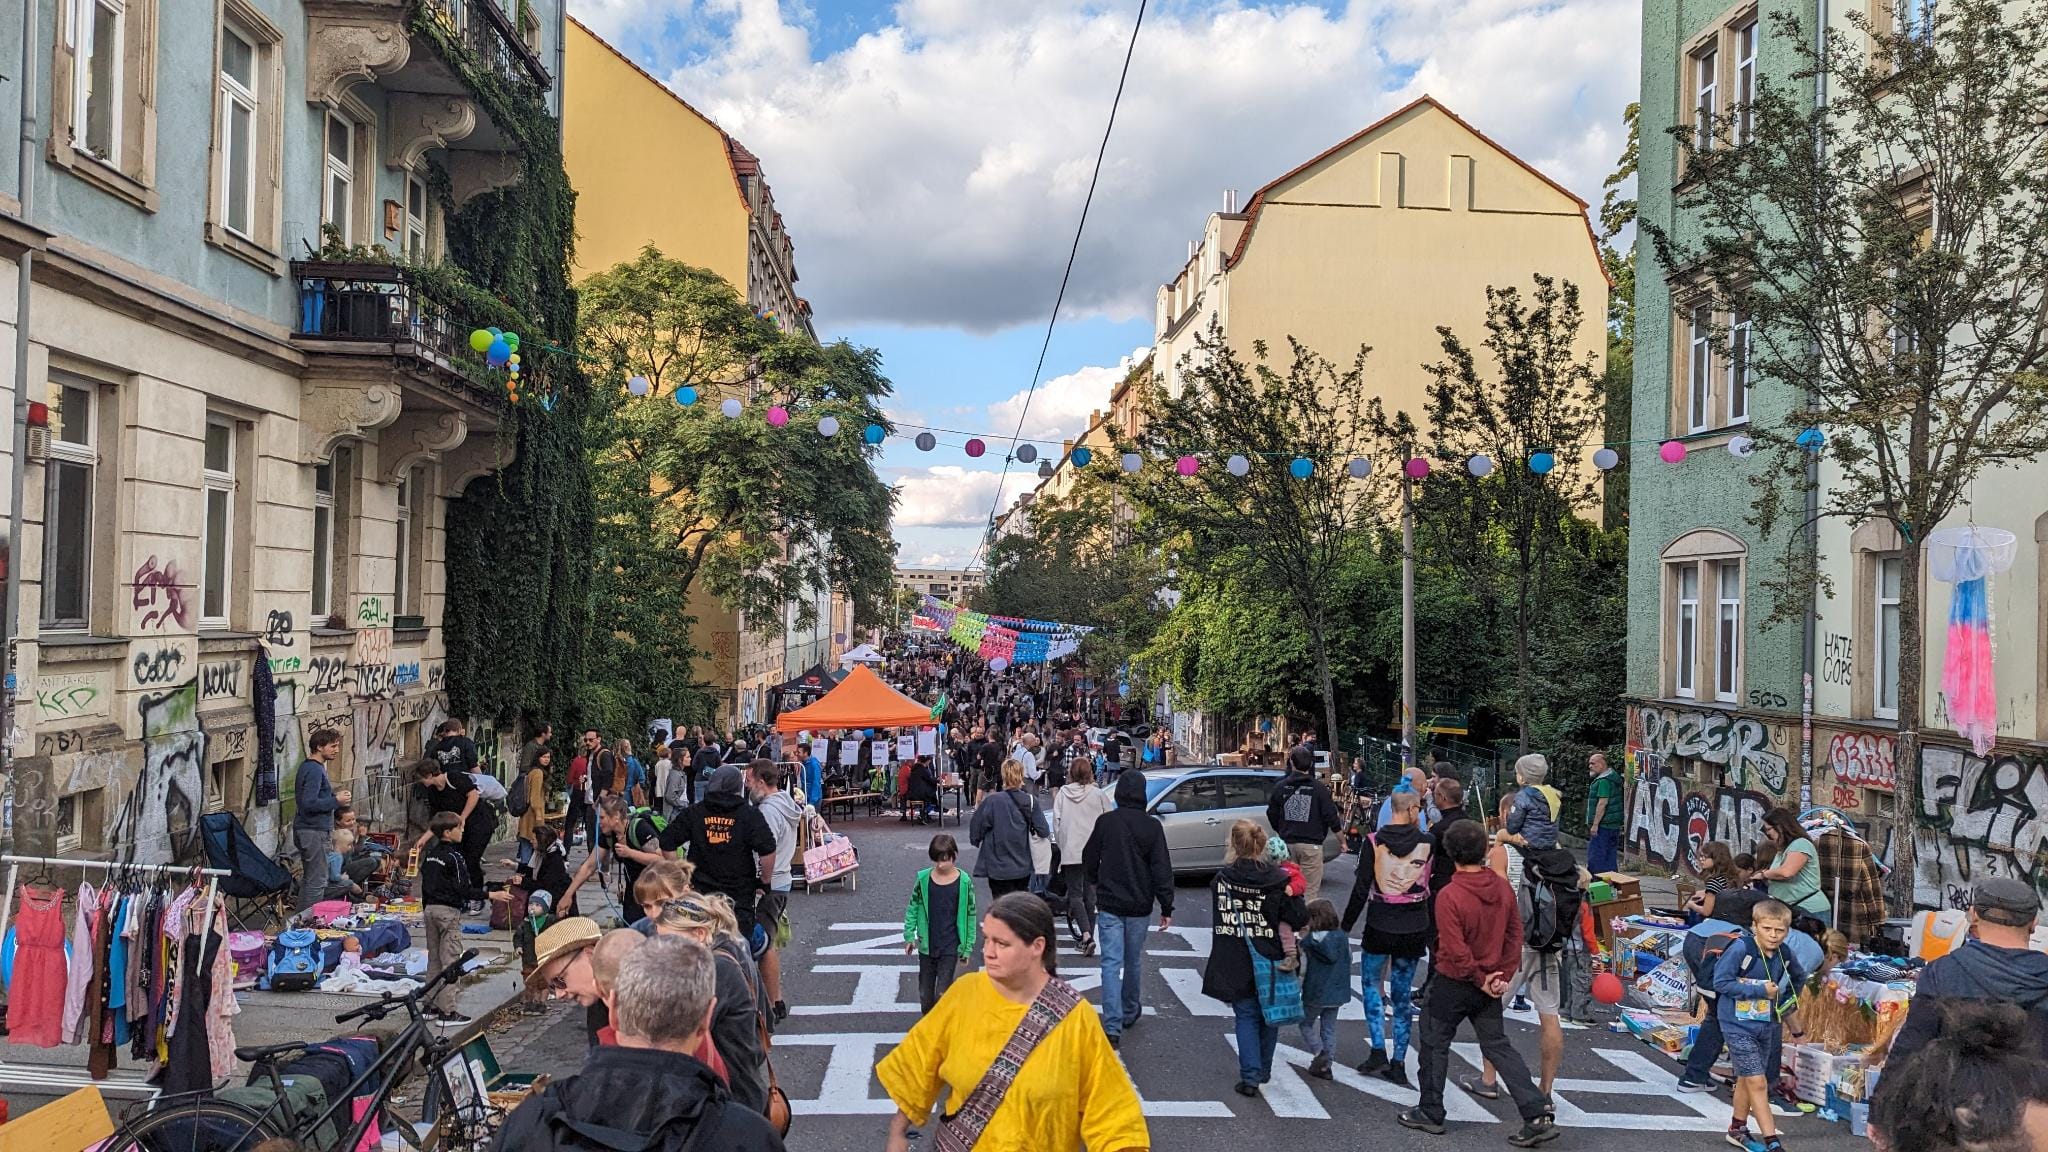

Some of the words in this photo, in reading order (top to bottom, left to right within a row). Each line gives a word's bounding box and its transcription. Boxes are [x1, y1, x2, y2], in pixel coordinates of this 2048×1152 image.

[1824, 632, 1852, 659] HATE
[268, 656, 301, 672] NTIFA
[1651, 970, 1687, 992] ACTION
